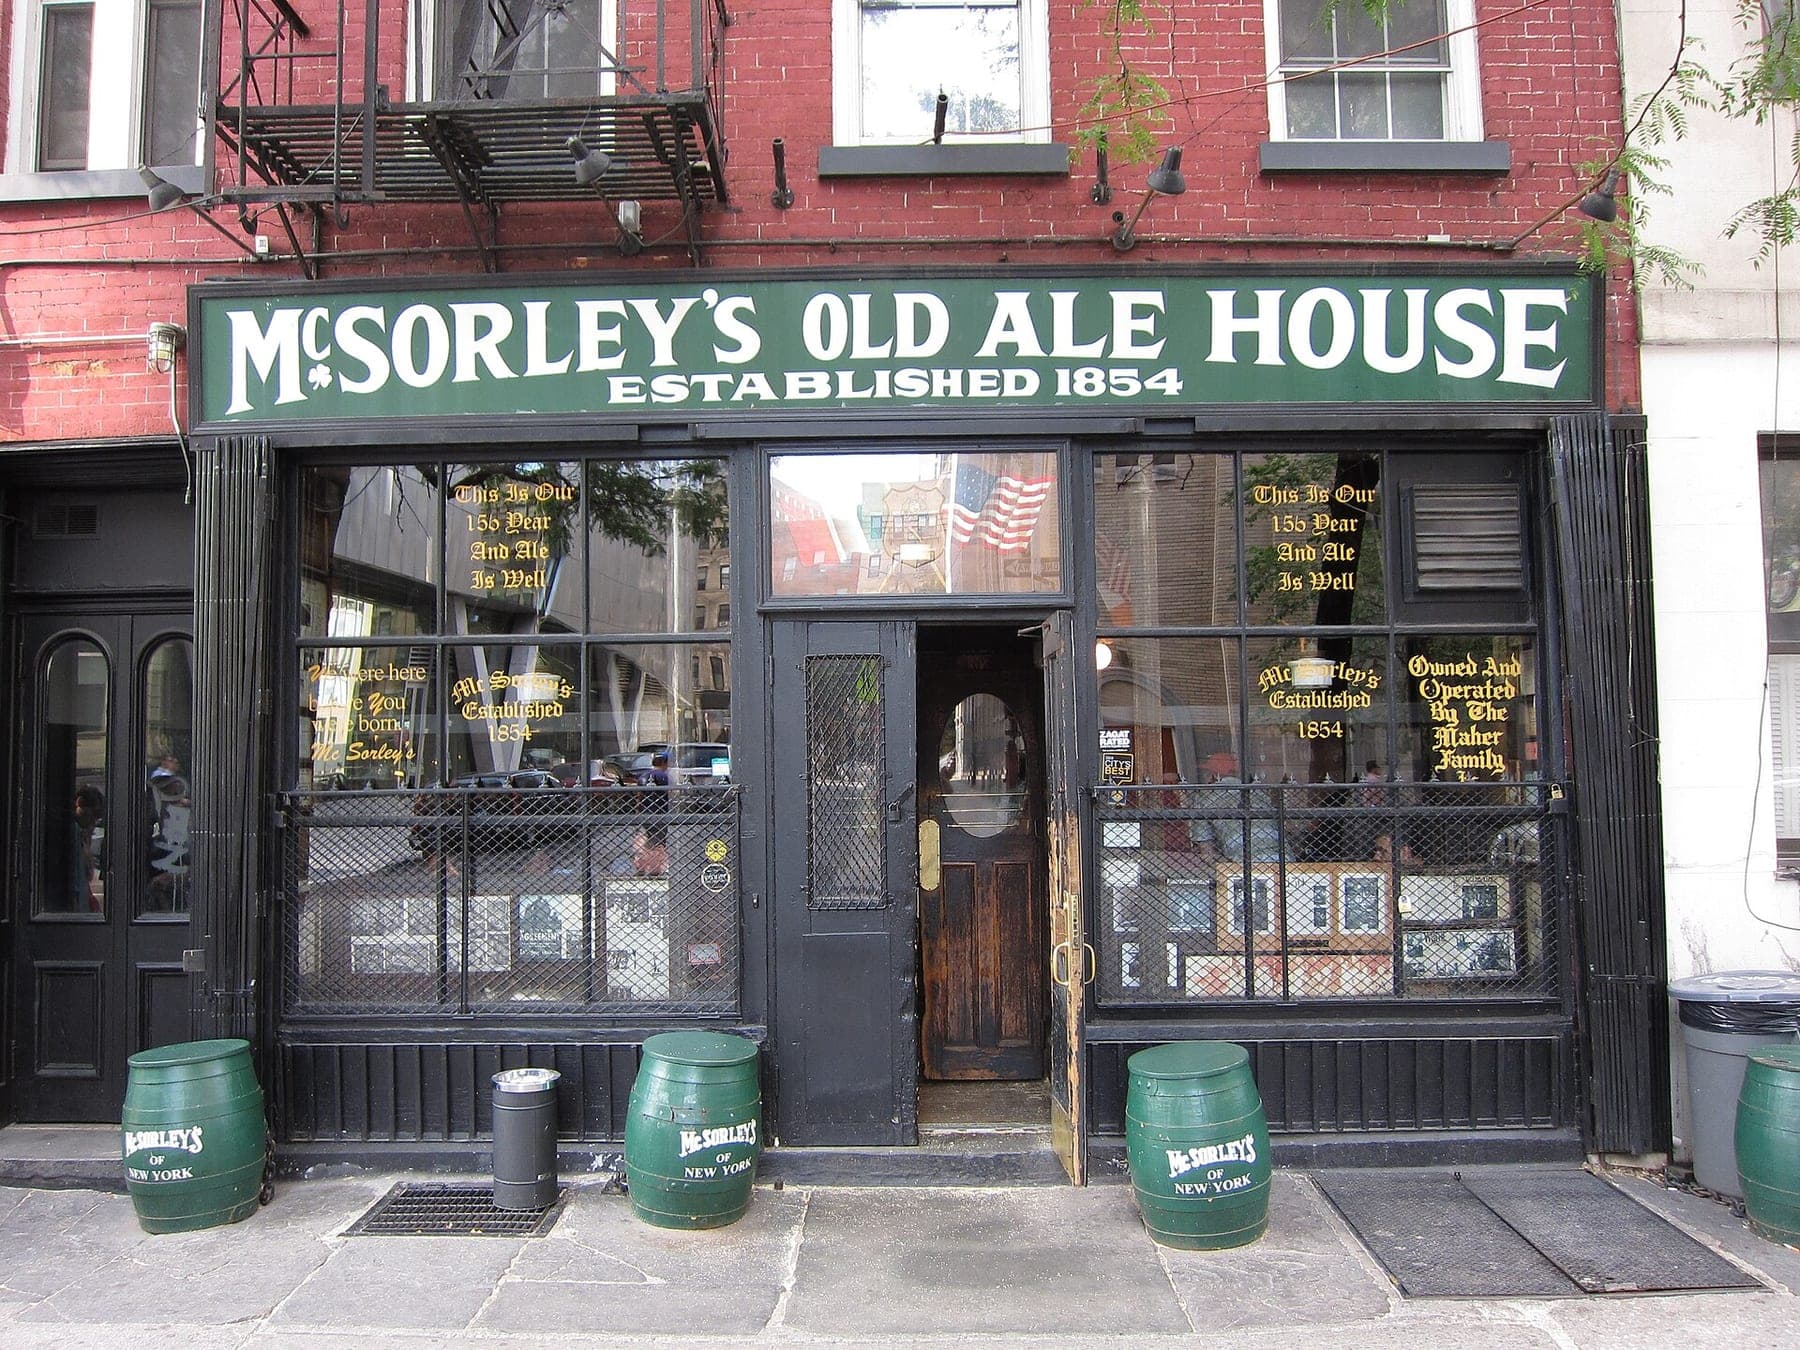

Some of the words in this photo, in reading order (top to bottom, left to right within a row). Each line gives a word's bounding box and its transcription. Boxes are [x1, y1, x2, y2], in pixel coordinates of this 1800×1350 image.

[802, 291, 950, 361] OLD
[974, 290, 1168, 361] ALE
[1205, 287, 1570, 391] HOUSE
[607, 367, 1040, 405] ESTABLISHED
[1055, 367, 1184, 398] 1854
[454, 484, 500, 505] This
[505, 483, 530, 502] Is
[535, 482, 577, 501] Our
[1254, 485, 1300, 508] This
[1305, 484, 1330, 503] Is
[1335, 484, 1376, 503] Our
[505, 511, 552, 534] Year
[1272, 515, 1307, 533] 156
[1311, 513, 1359, 536] Year
[470, 541, 509, 561] And
[515, 540, 550, 560] Ale
[1277, 542, 1317, 562] And
[1322, 542, 1356, 562] Ale
[470, 570, 496, 590] Is
[501, 569, 546, 589] Well
[1278, 571, 1304, 591] Is
[1308, 571, 1355, 591] Well
[389, 662, 427, 681] here
[1407, 652, 1478, 677] Owned
[1481, 652, 1521, 677] And
[1258, 665, 1293, 694] Mc
[451, 677, 486, 705] Mc
[1269, 690, 1371, 712] Established
[1419, 678, 1516, 706] Operated
[368, 692, 406, 716] You
[461, 700, 563, 721] Established
[1428, 700, 1460, 728] By
[1465, 700, 1509, 722] The
[488, 723, 533, 742] 1854
[1297, 720, 1344, 739] 1854
[1431, 723, 1504, 752] Maher
[311, 743, 340, 761] Mc
[346, 741, 416, 764] Sorley's
[1435, 747, 1506, 776] Family
[1105, 768, 1130, 776] BEST
[149, 1155, 165, 1165] OF
[684, 1167, 717, 1178] NEW
[722, 1156, 752, 1176] YORK
[715, 1152, 731, 1163] OF
[128, 1167, 149, 1180] NEW
[152, 1167, 193, 1181] YORK
[1174, 1183, 1208, 1194] NEW
[1212, 1172, 1252, 1192] YORK
[1207, 1169, 1224, 1180] OF
